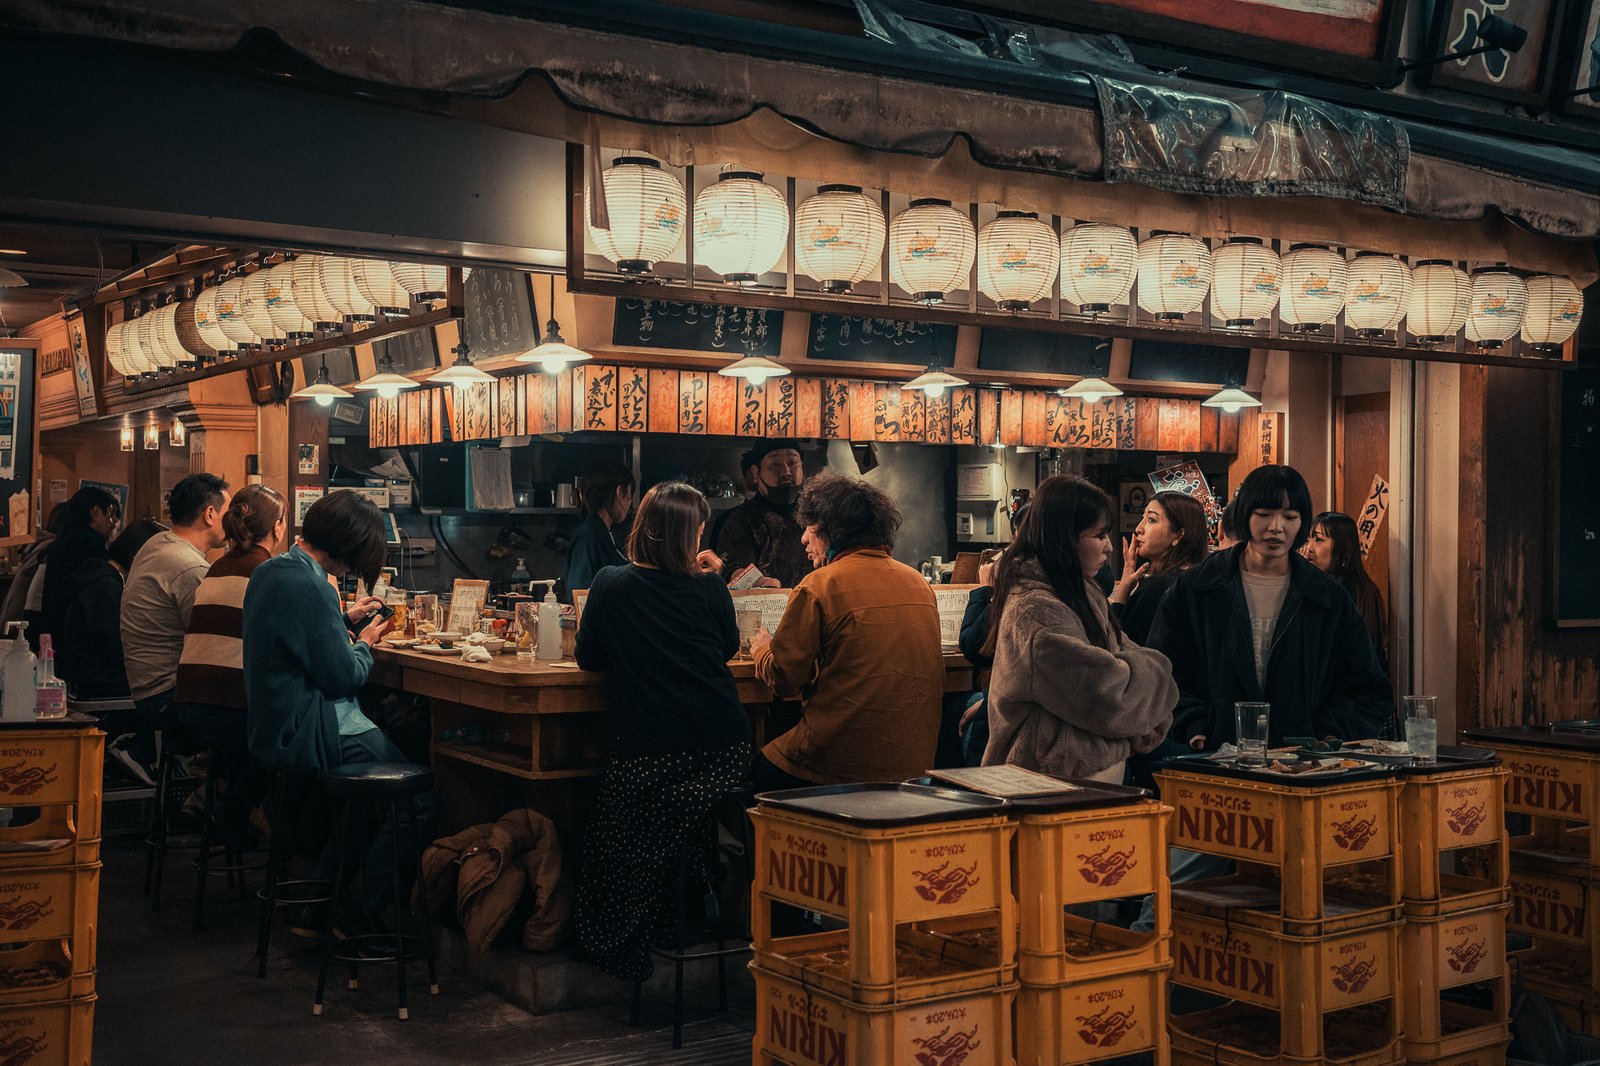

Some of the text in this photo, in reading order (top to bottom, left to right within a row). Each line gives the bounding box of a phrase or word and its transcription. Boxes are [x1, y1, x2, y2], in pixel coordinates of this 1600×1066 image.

[629, 373, 647, 430] 大とろ
[1200, 791, 1252, 812] キリンビール
[1503, 775, 1583, 814] KIRI
[786, 834, 828, 858] キリンビール
[1087, 828, 1125, 842] 大びん20本
[1178, 804, 1274, 854] KIRIN
[924, 843, 967, 859] 大びん20本
[768, 847, 847, 906] KIRIN
[1503, 893, 1584, 938] KIRI
[1178, 941, 1274, 998] KIRIN
[1086, 988, 1125, 1004] 大びん20本
[769, 1004, 847, 1066] KIRIN
[924, 1007, 967, 1025] 大びん20本
